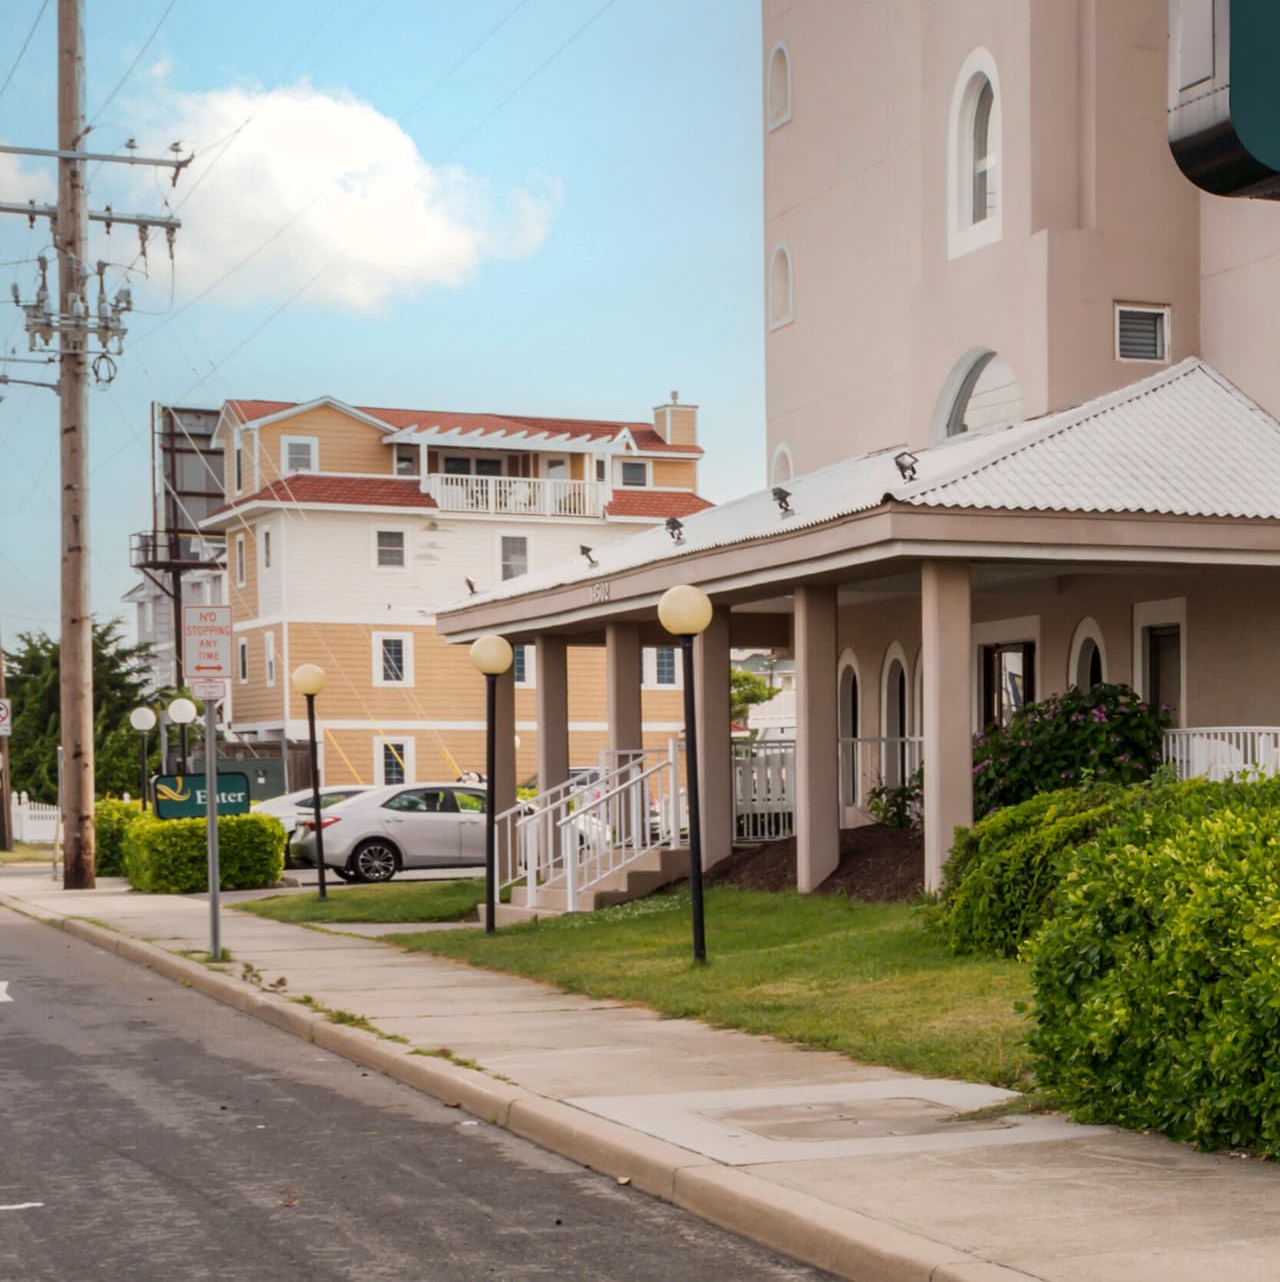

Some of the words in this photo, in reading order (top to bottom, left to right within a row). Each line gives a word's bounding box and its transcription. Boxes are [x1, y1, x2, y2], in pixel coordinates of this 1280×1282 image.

[199, 611, 217, 622] NO
[187, 625, 231, 636] STOPPING
[199, 639, 218, 648] ANY
[198, 652, 219, 660] TIME
